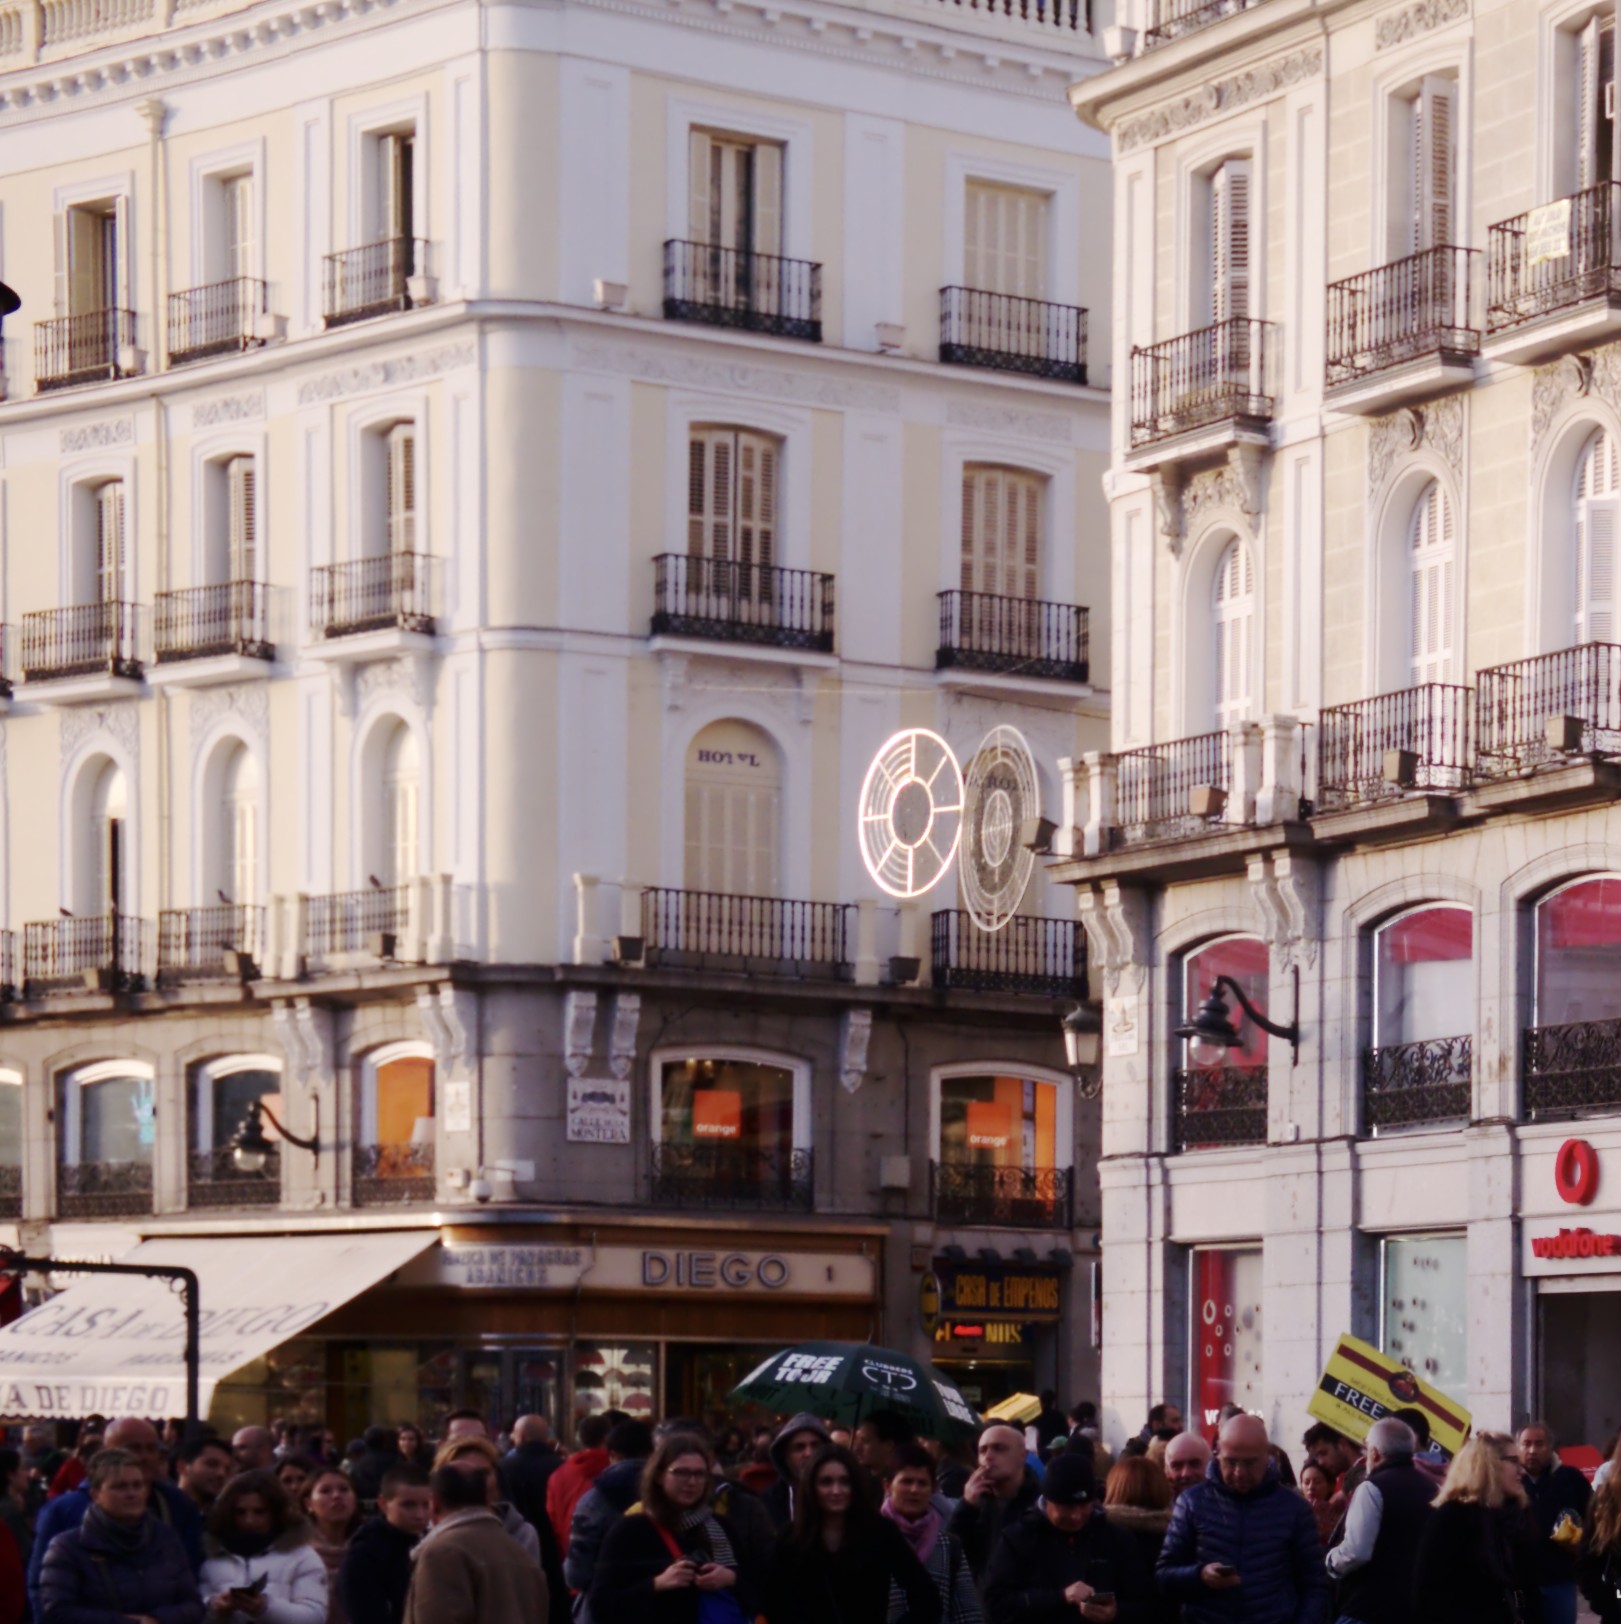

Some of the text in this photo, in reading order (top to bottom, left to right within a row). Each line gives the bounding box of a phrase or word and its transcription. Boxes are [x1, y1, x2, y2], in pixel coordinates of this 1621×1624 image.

[697, 1123, 737, 1135] orange
[969, 1134, 1007, 1147] orange
[641, 1250, 791, 1290] DIEGO
[780, 1353, 845, 1371] FREE
[35, 1385, 71, 1411] DE
[80, 1385, 169, 1412] DIEGO
[1334, 1383, 1385, 1420] FREE
